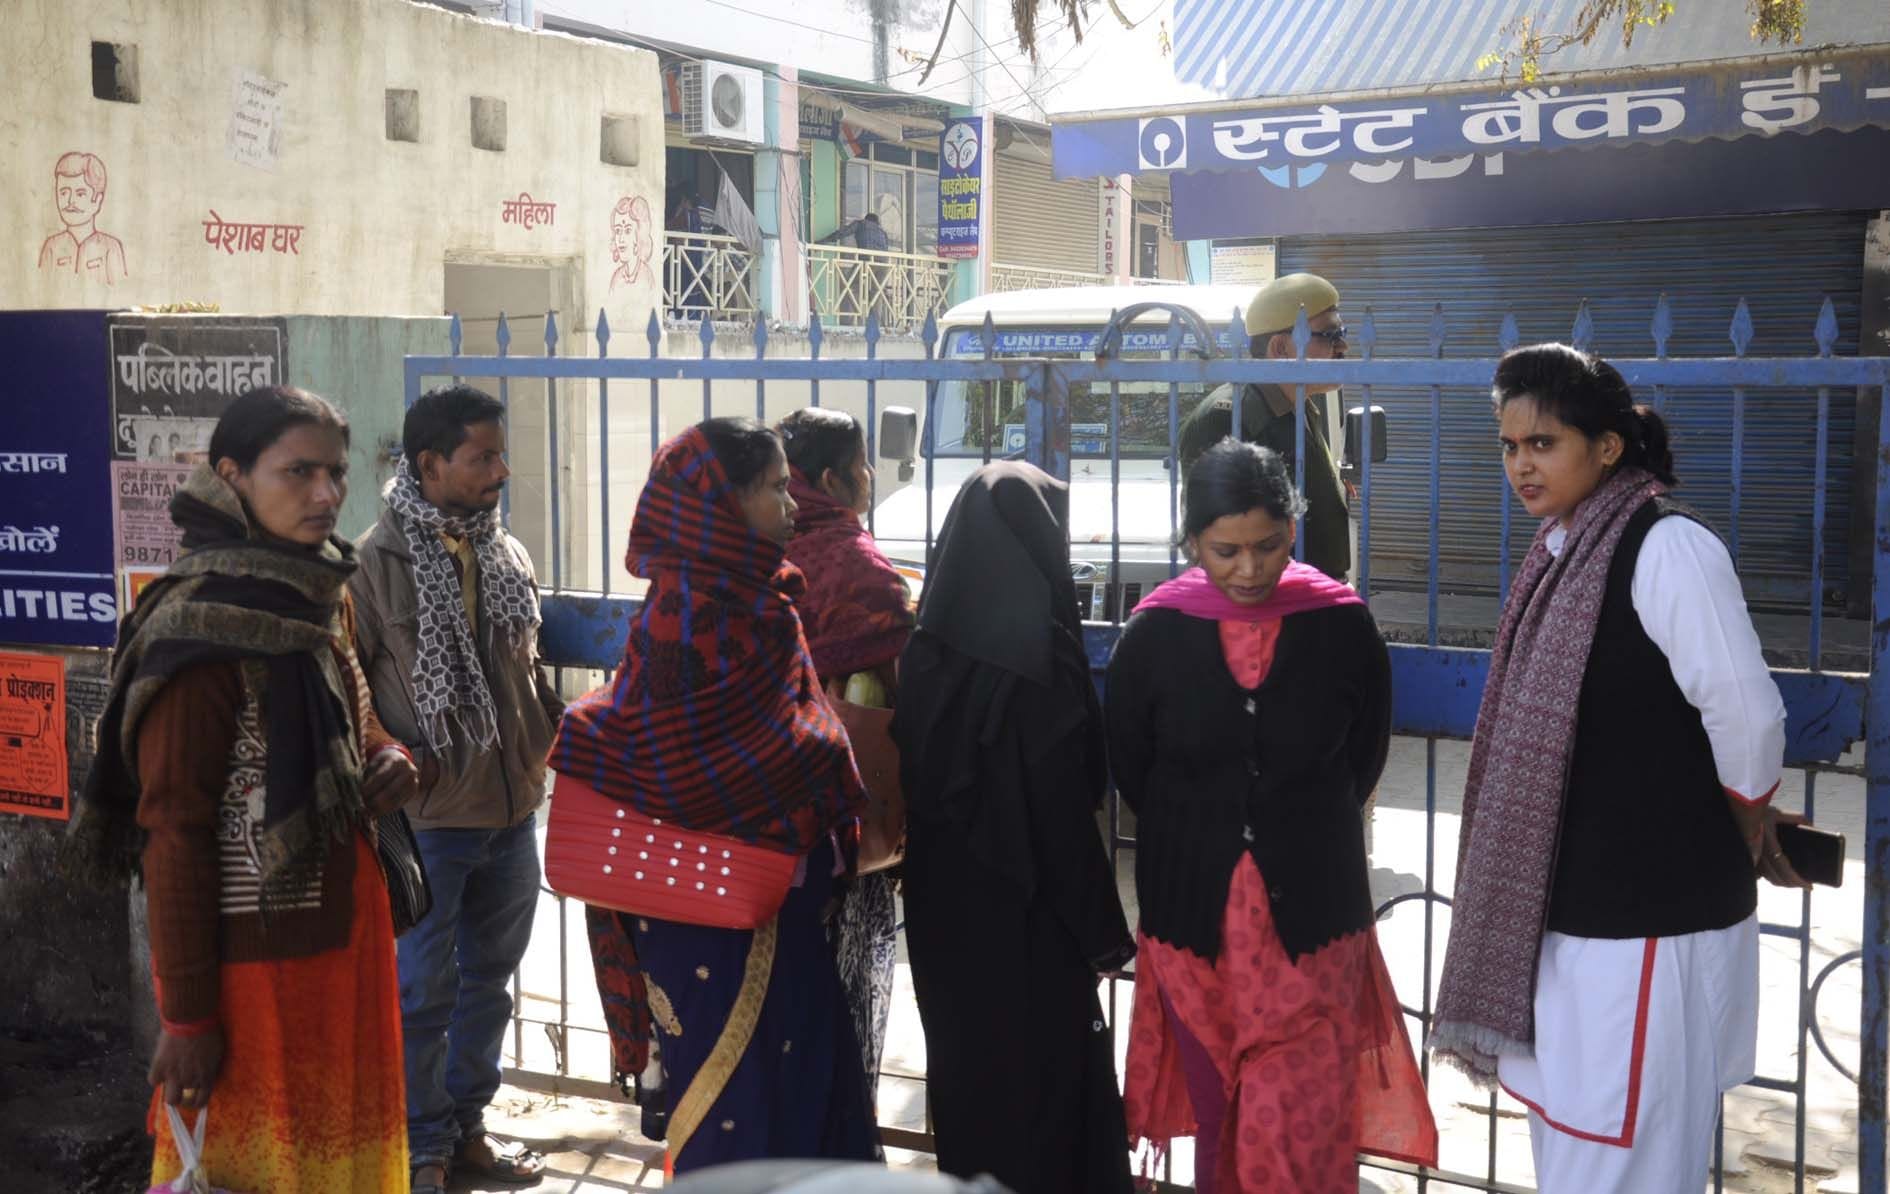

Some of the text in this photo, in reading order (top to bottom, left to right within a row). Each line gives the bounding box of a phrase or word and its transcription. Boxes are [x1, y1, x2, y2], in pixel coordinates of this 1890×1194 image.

[1213, 104, 1428, 160] स्टेट
[1460, 86, 1686, 145] बैंक
[502, 192, 557, 231] महिला
[201, 209, 305, 256] पेशाब घर
[1104, 195, 1115, 275] TAILORS
[1003, 335, 1083, 346] UNITED
[0, 452, 68, 473] सान
[124, 546, 173, 563] 9871
[0, 588, 117, 622] ITIES
